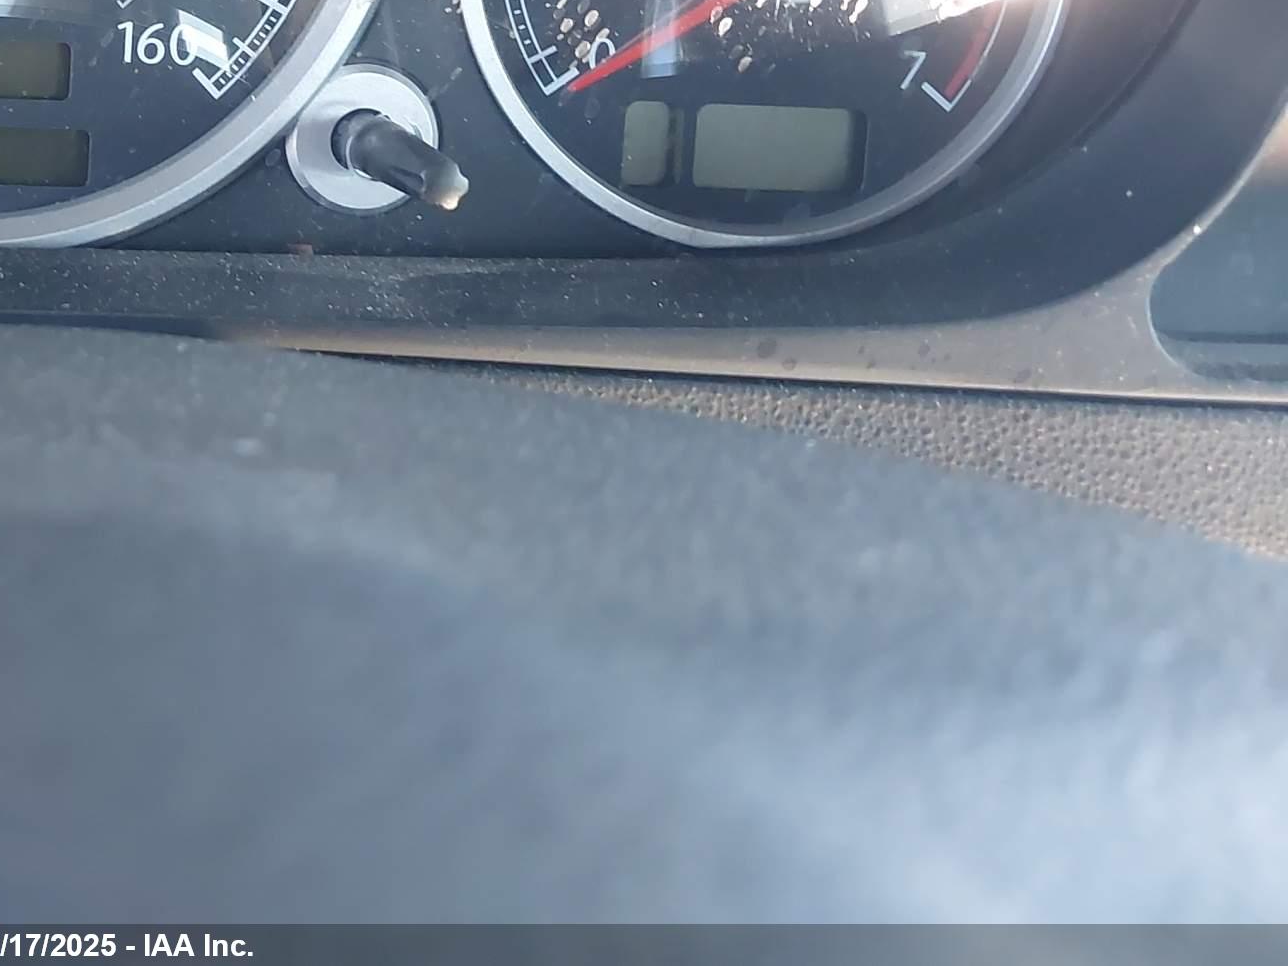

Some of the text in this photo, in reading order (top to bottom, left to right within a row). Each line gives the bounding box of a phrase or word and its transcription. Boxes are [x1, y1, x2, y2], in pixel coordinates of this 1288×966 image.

[117, 22, 197, 66] 160
[589, 39, 614, 69] 0
[900, 51, 927, 89] 7
